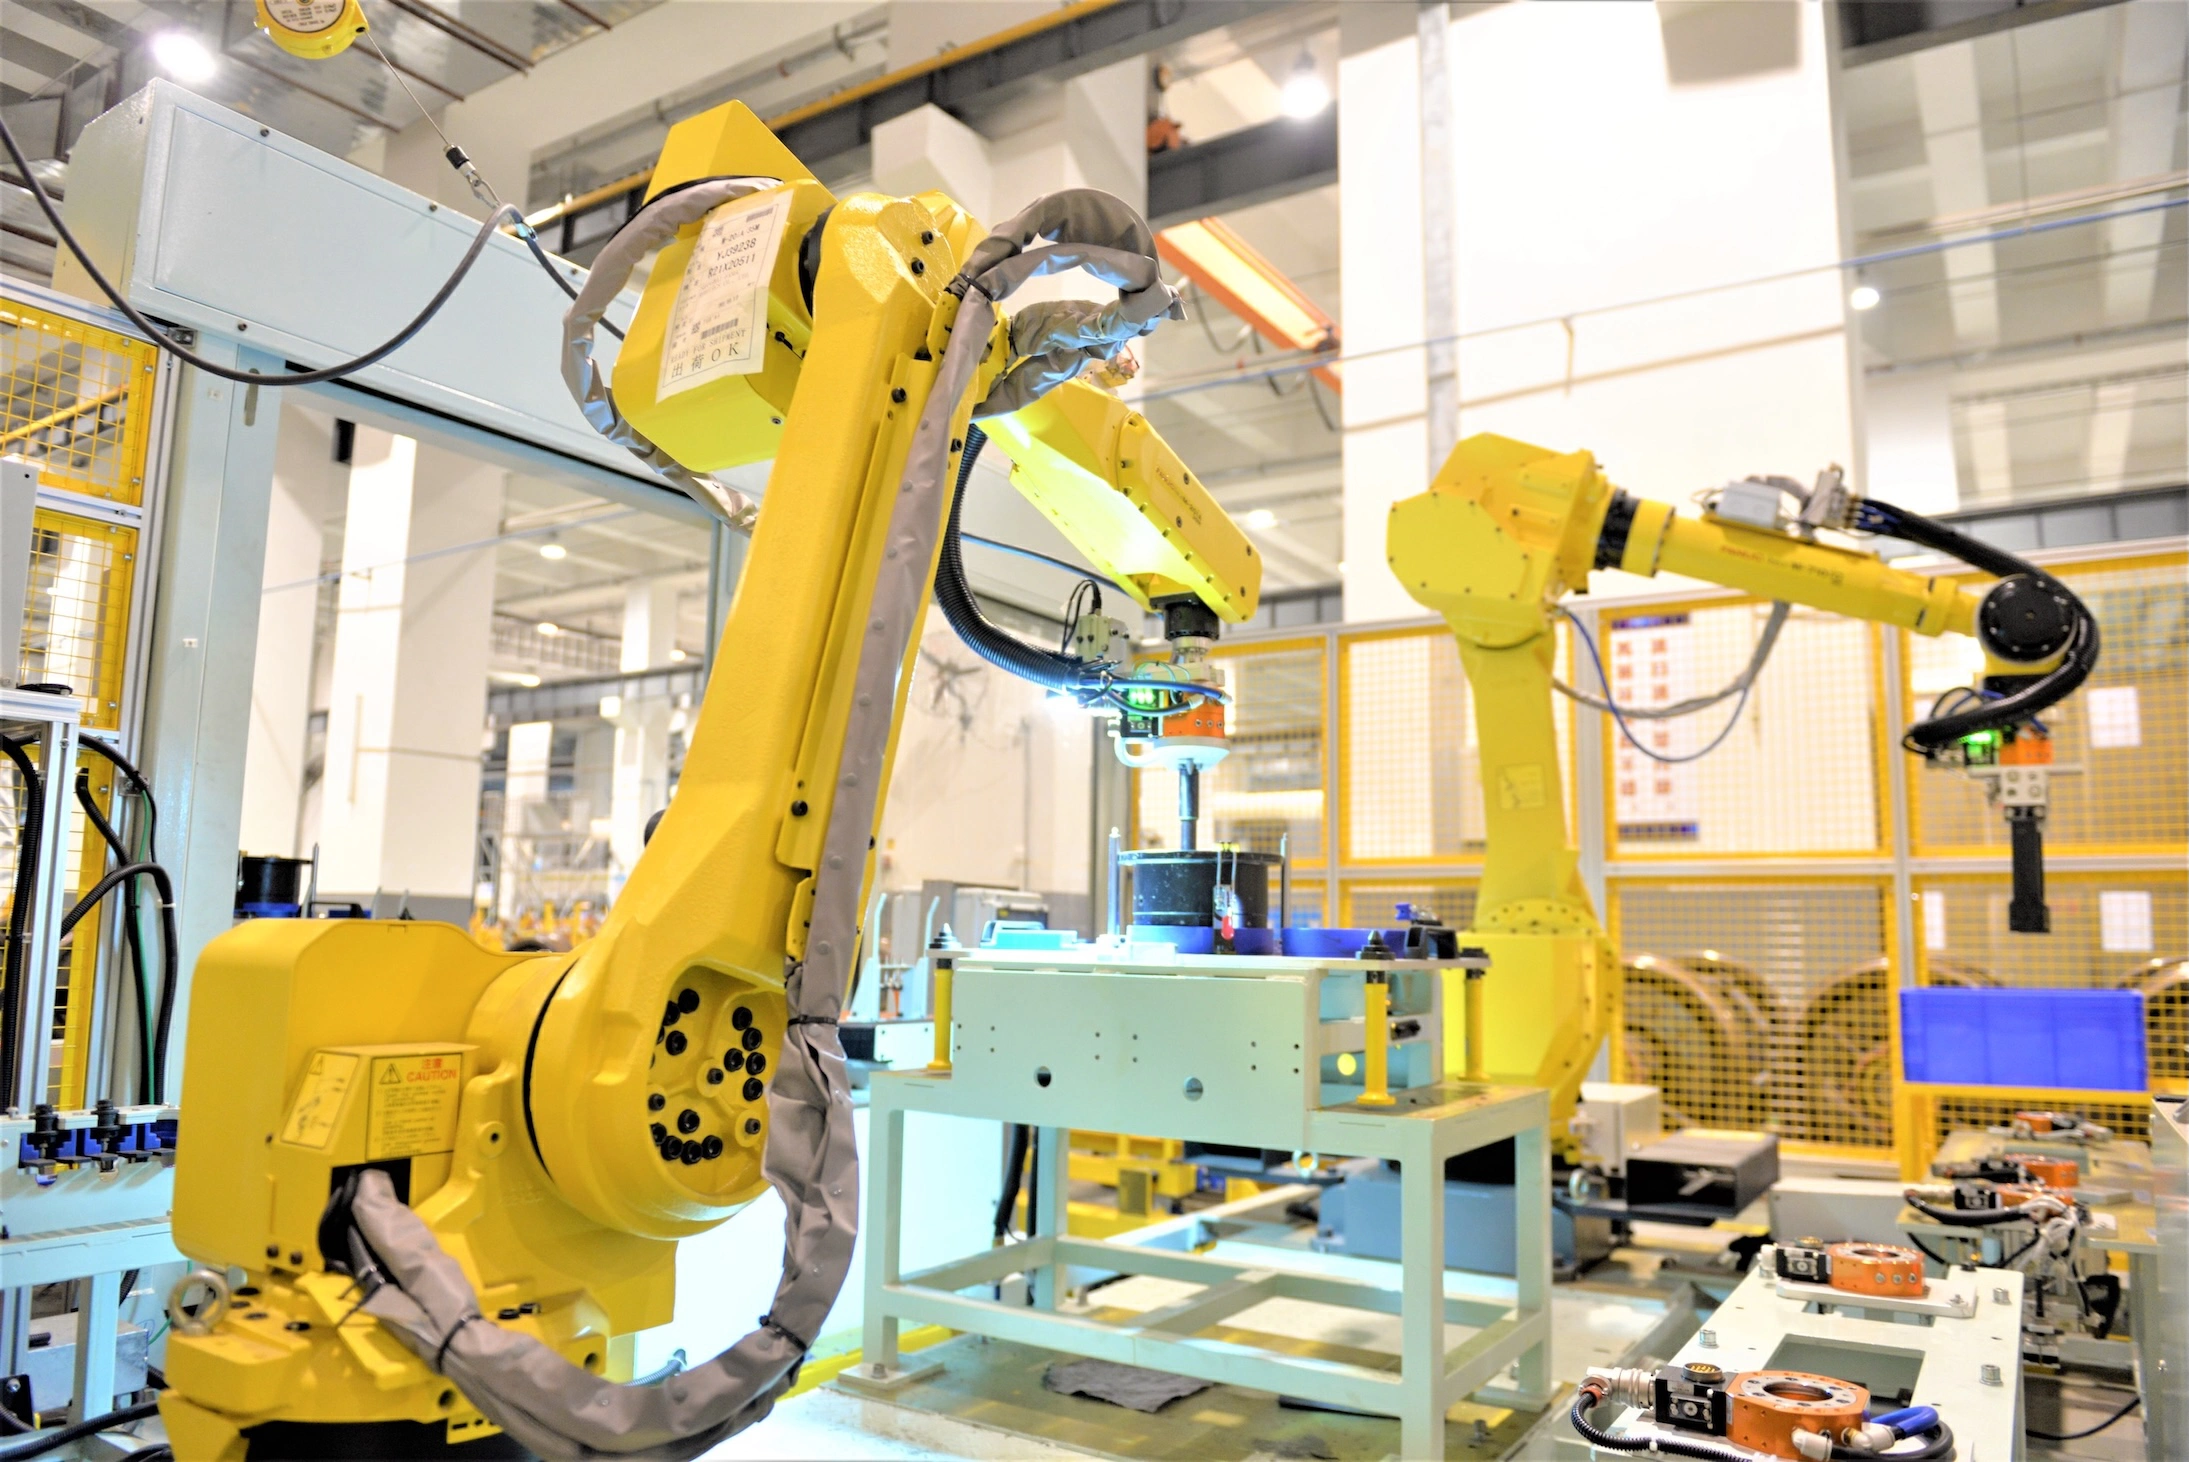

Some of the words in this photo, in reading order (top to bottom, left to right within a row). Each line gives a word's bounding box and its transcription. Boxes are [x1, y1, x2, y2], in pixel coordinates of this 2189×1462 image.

[716, 237, 757, 261] YJ39238
[707, 253, 756, 279] R21X20511
[693, 343, 706, 355] FOR
[709, 328, 746, 348] SHIPMENT
[406, 1069, 457, 1083] CAUTION
